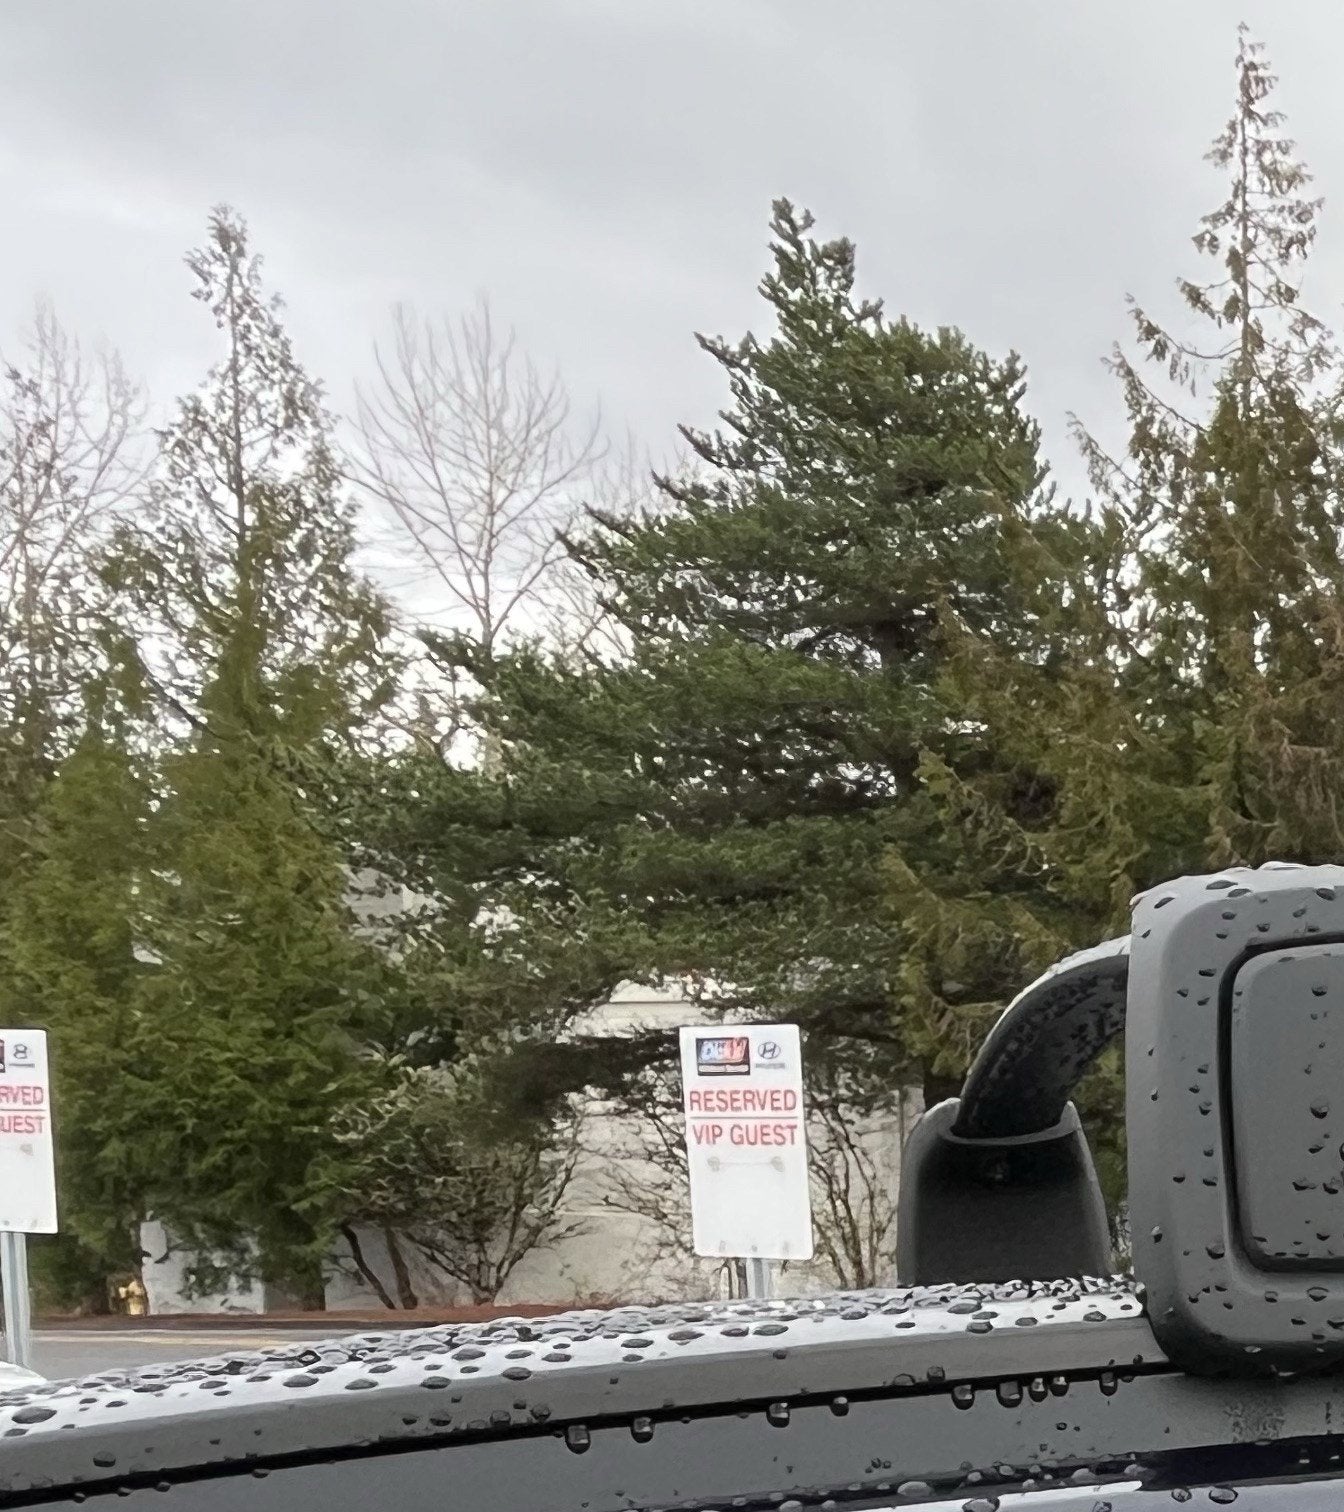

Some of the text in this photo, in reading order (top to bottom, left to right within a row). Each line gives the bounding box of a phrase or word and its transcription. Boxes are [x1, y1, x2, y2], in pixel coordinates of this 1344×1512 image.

[690, 1089, 797, 1112] RESERVED
[692, 1123, 798, 1146] VIP GUEST
